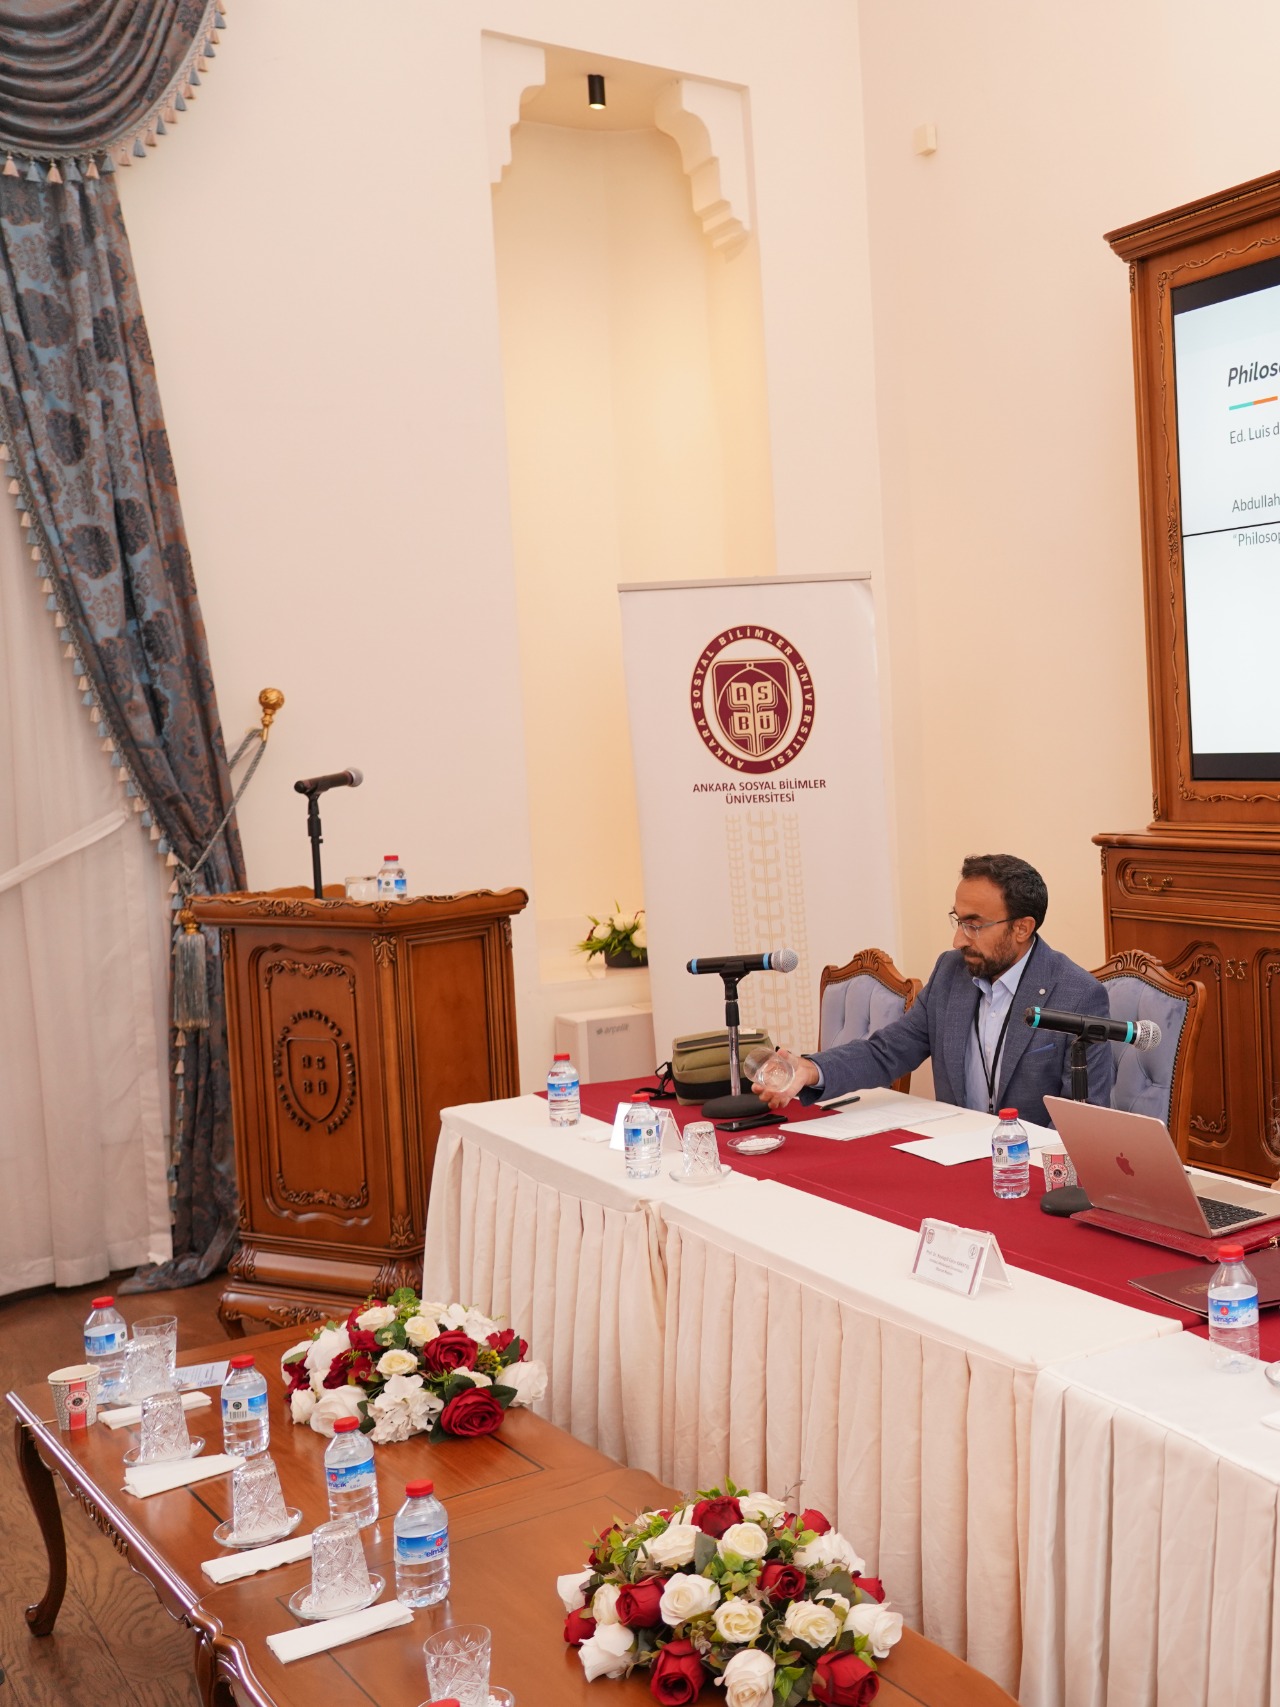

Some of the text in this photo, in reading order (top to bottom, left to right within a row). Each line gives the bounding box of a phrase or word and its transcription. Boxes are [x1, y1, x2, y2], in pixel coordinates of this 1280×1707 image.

[1229, 430, 1246, 445] Ed.
[1248, 425, 1271, 441] Luis
[1232, 493, 1280, 513] Abdullah
[693, 626, 813, 770] ANKARA SOSYAL BİLİMLER ÜNİVERSİTESİ
[693, 778, 827, 793] ANKARA SOSYAL BİLİMLER
[725, 791, 795, 804] ÜNİVERSİTESİ
